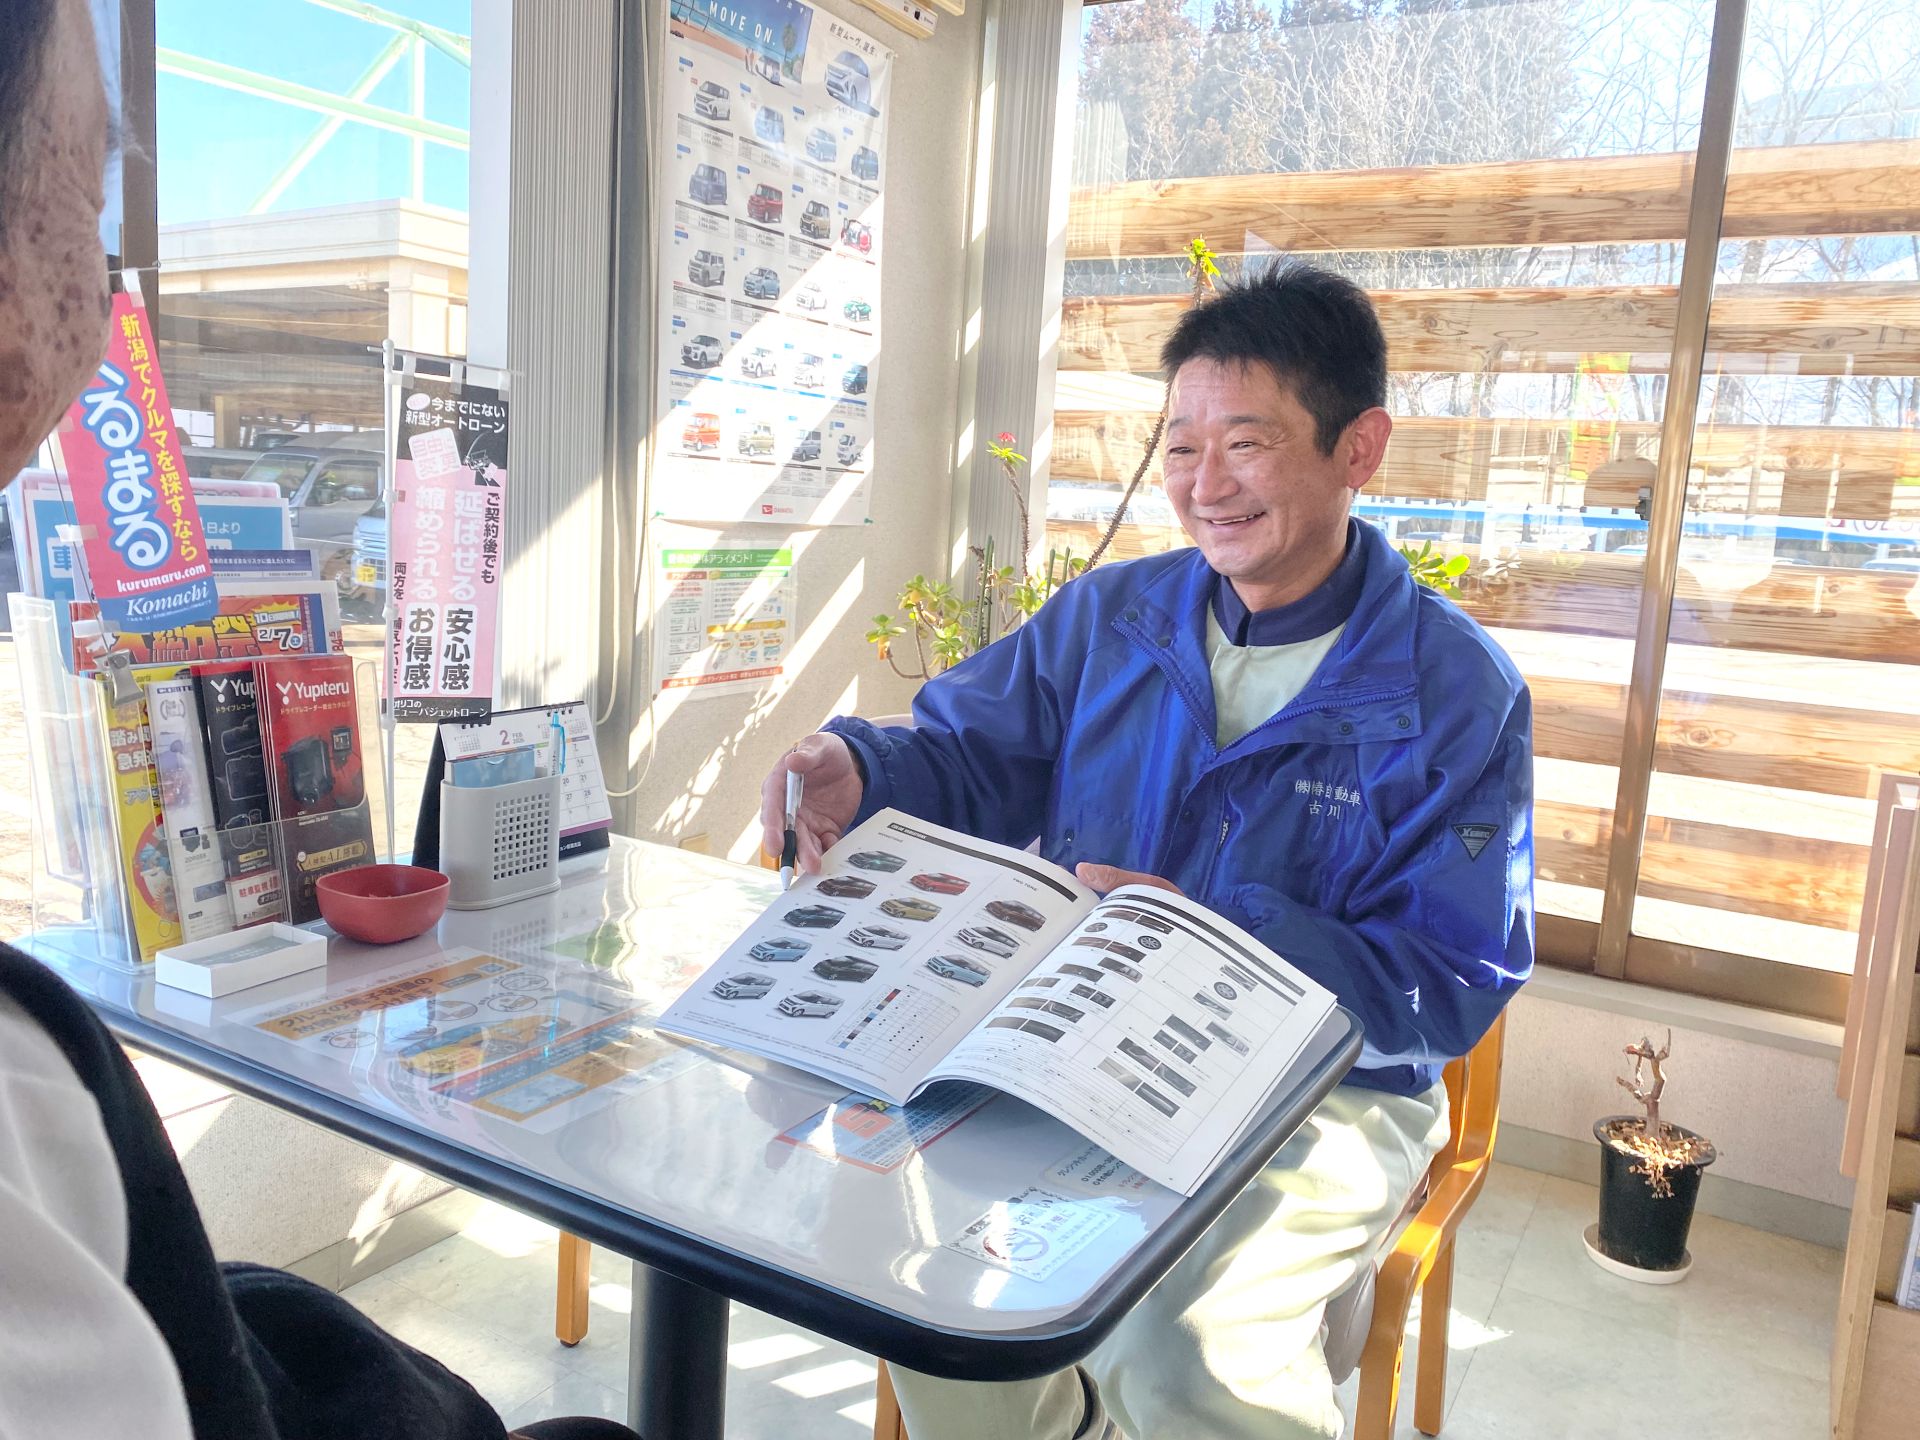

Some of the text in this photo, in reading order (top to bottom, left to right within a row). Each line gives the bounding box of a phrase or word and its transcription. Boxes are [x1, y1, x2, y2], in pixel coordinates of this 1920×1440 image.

[709, 1, 747, 31] MOVE
[754, 23, 776, 46] ON.
[406, 410, 505, 433] 新型オートローン
[432, 397, 505, 417] 今までにない
[119, 313, 198, 562] 新潟でクルマを探すなら
[411, 486, 446, 601] 縮められる
[451, 489, 483, 601] 延ばせる
[480, 492, 500, 584] ご契約後でも
[117, 563, 206, 592] kurumaru.com
[126, 581, 208, 616] Komachi
[259, 627, 291, 650] 2/7
[403, 607, 435, 690] お得感
[441, 607, 474, 691] 安心感
[294, 681, 349, 701] Yupiteru
[499, 729, 510, 746] 2
[1309, 800, 1341, 820] 古川
